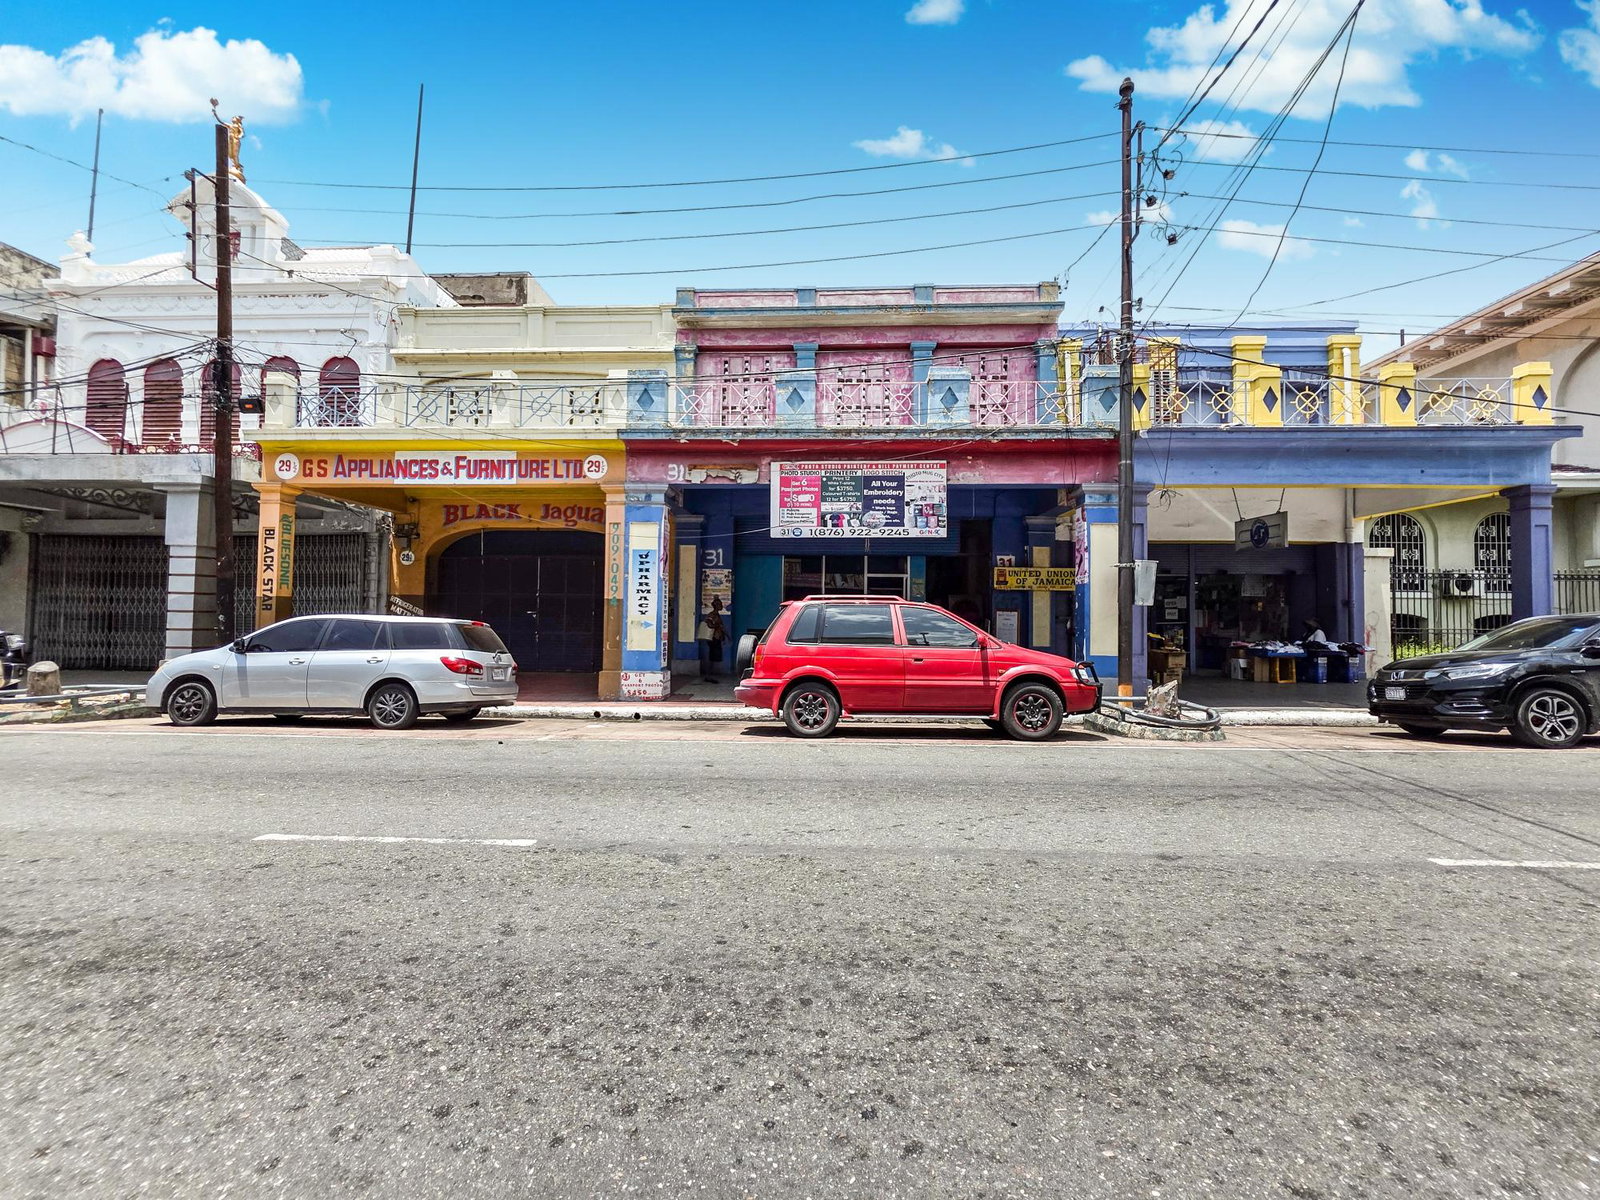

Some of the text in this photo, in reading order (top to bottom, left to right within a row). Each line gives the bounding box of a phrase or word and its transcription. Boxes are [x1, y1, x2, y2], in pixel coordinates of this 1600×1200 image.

[442, 503, 605, 527] BLACK Jagua
[849, 528, 910, 537] 922-9245
[704, 548, 723, 566] 31
[261, 528, 276, 611] BLACK STAR
[1008, 570, 1076, 578] UNITED UNION
[636, 560, 652, 615] PHARMACY
[1015, 577, 1028, 585] OF
[1032, 577, 1076, 586] JAMAICA
